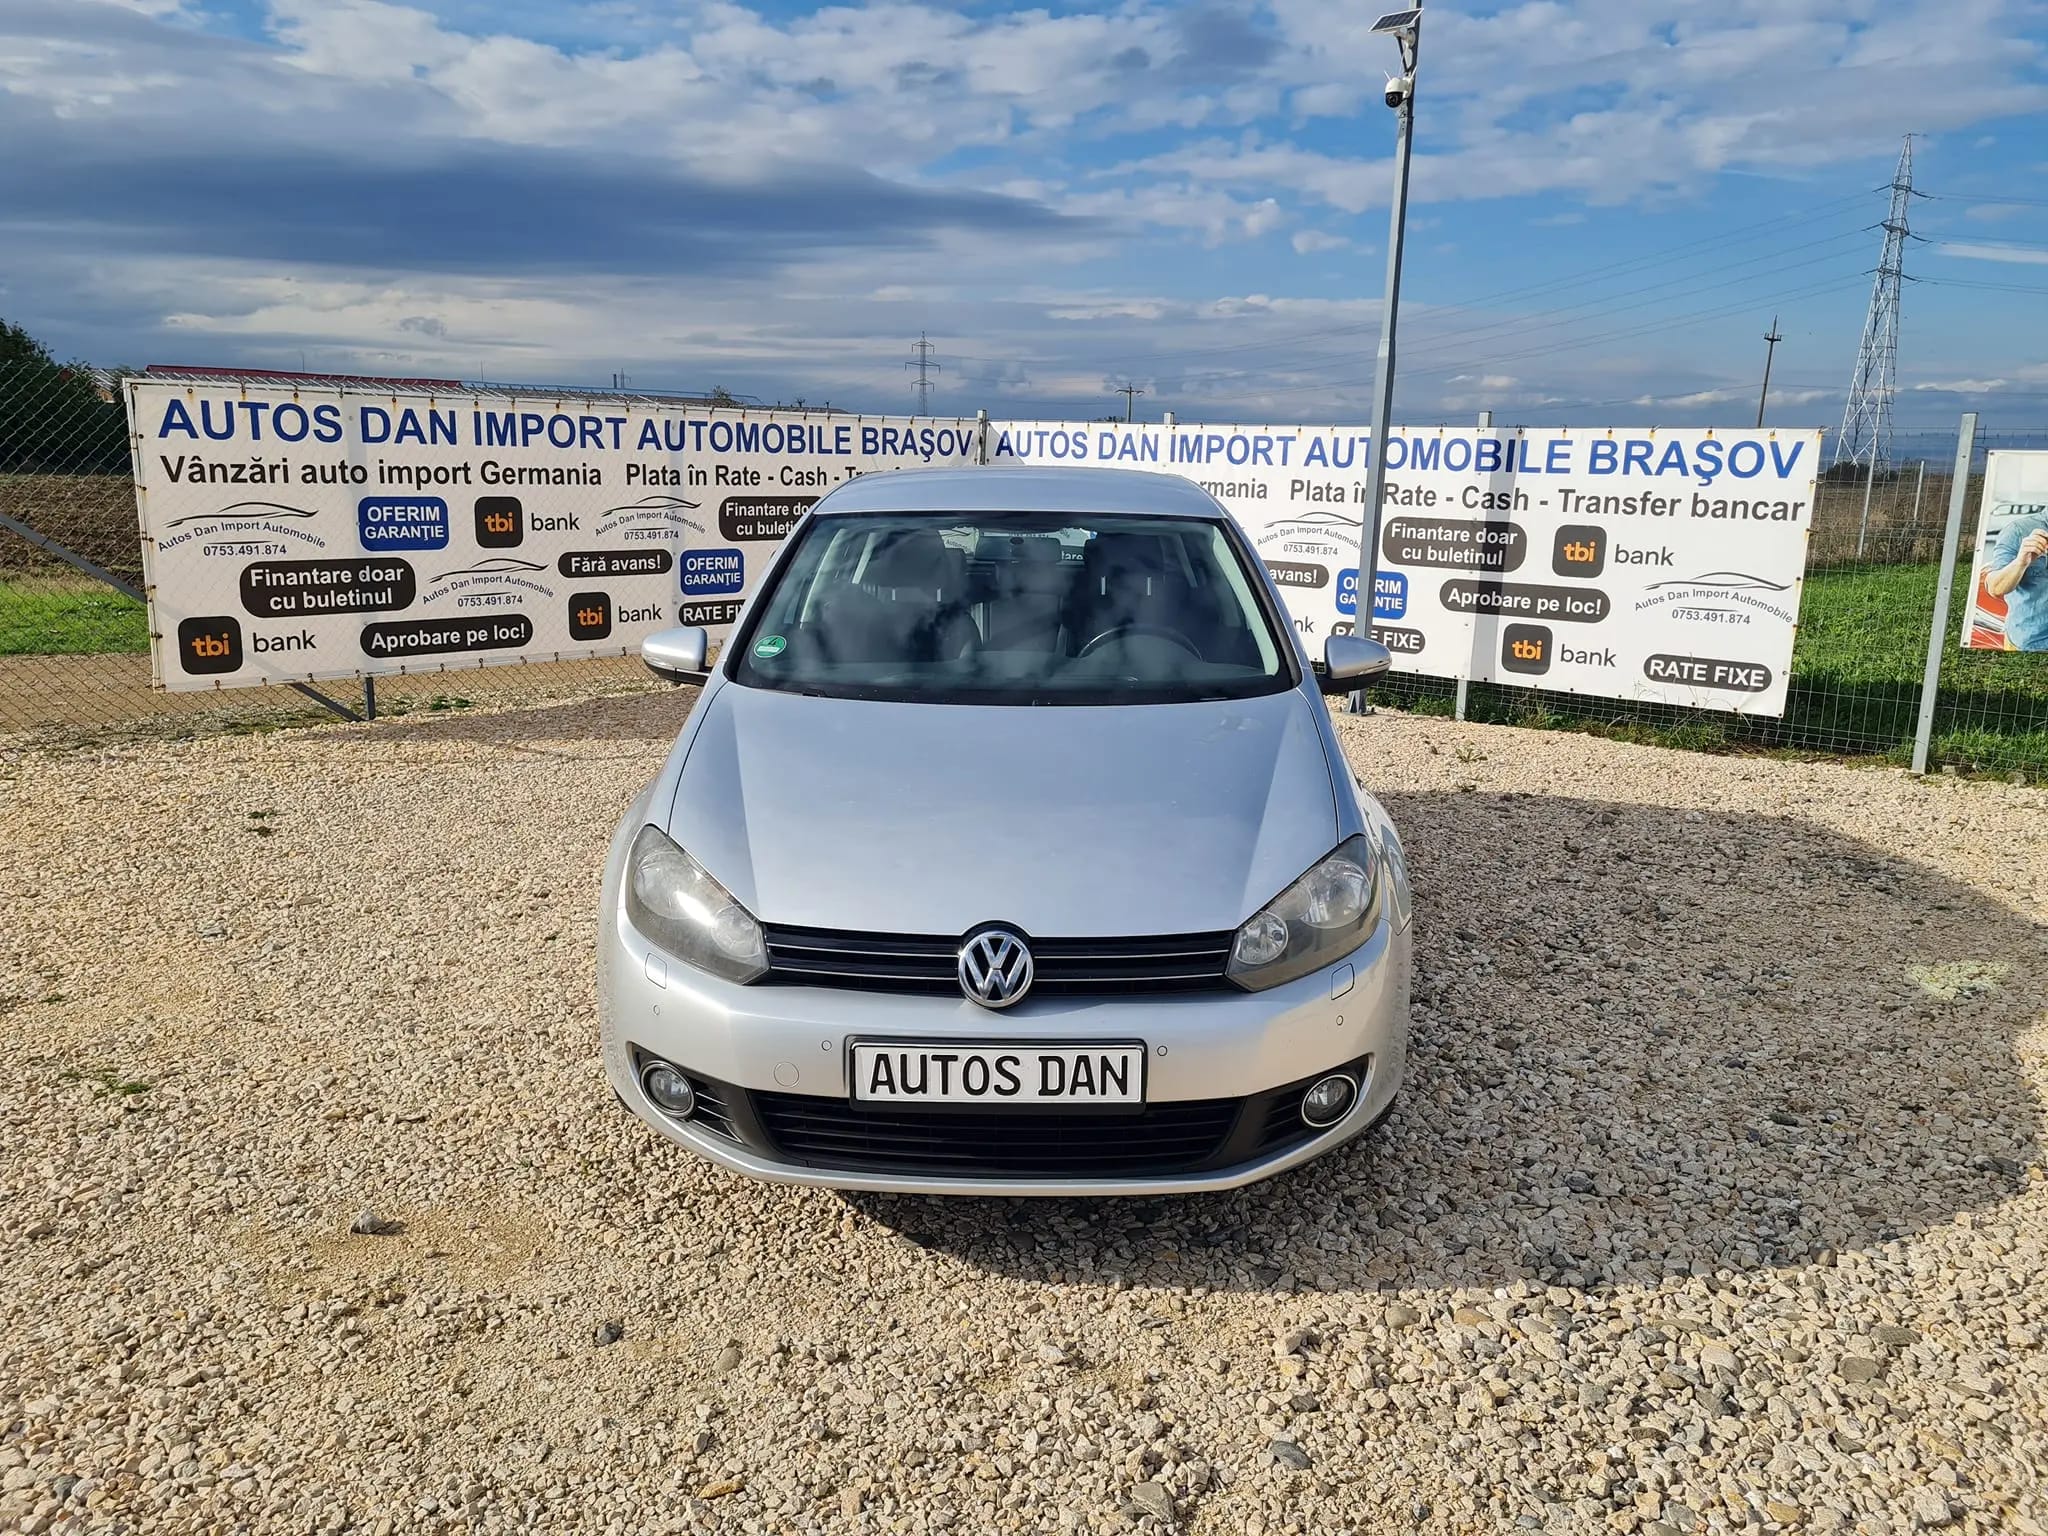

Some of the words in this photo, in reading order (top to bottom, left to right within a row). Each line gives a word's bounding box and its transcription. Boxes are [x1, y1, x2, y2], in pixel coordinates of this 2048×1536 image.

[158, 399, 343, 443] AUTOS
[360, 406, 457, 445] DAN
[474, 411, 627, 450] IMPORT
[637, 418, 851, 455] AUTOMOBILE
[995, 430, 1088, 459] AUTOS
[1098, 432, 1159, 462] DAN
[1170, 434, 1297, 467] IMPORT
[160, 455, 289, 484] Vânzări
[301, 459, 368, 484] auto
[378, 459, 472, 491] import
[480, 460, 602, 485] Germania
[626, 463, 682, 486] Plata
[688, 465, 708, 486] în
[715, 465, 761, 487] Rate
[780, 466, 828, 486] Cash
[1200, 478, 1268, 499] mania
[725, 502, 790, 517] Finantare
[792, 502, 809, 516] do
[1290, 479, 1346, 503] Plata
[1383, 482, 1437, 507] Rate
[1461, 485, 1529, 510] Cash
[1558, 488, 1682, 517] Transfer
[1690, 492, 1806, 522] bancar
[367, 506, 441, 522] OFERIM
[484, 511, 514, 533] tbi
[530, 512, 580, 532] bank
[595, 521, 619, 537] Autos
[619, 515, 635, 525] Dan
[636, 511, 663, 522] Import
[663, 512, 706, 535] Automobile
[157, 531, 193, 552] Autos
[193, 524, 219, 537] Dan
[221, 521, 260, 533] Import
[262, 521, 326, 549] Automobile
[624, 530, 679, 541] 0753.491.874
[736, 524, 753, 536] cu
[1257, 532, 1279, 547] Autos
[1279, 527, 1295, 537] Dan
[1297, 526, 1323, 535] Import
[1391, 522, 1470, 543] Finantare
[1475, 527, 1518, 545] doar
[203, 544, 288, 557] 0753.491.874
[1283, 543, 1338, 556] 0753.491.874
[1401, 546, 1422, 560] cu
[1427, 545, 1504, 566] buletinul
[1563, 541, 1596, 563] tbi
[1614, 544, 1675, 567] bank
[571, 555, 607, 574] Fără
[611, 554, 662, 572] avans!
[686, 556, 739, 572] OFERIM
[250, 567, 353, 587] Finantare
[358, 565, 405, 583] doar
[1269, 568, 1318, 584] avans!
[1343, 576, 1402, 594] ORIM
[269, 595, 296, 610] cu
[302, 587, 393, 608] buletinul
[421, 586, 450, 605] Autos
[450, 579, 470, 591] Dan
[471, 576, 503, 587] Import
[504, 575, 554, 598] Automobile
[457, 594, 523, 608] 0753.491.874
[1339, 593, 1404, 611] GANŢIE
[1447, 588, 1531, 610] Aprobare
[1536, 598, 1560, 614] pe
[1565, 596, 1602, 616] loc!
[1634, 596, 1666, 612] Autos
[1667, 590, 1690, 602] Dan
[1692, 588, 1730, 600] Import
[1731, 592, 1793, 623] Automobile
[577, 606, 603, 627] tbi
[618, 603, 663, 623] bank
[683, 605, 722, 622] RATE
[1294, 616, 1314, 633] nk
[1671, 608, 1752, 625] 0753.491.874
[191, 632, 230, 657] tbi
[252, 629, 317, 653] bank
[371, 629, 461, 652] Aprobare
[466, 628, 489, 646] pe
[493, 623, 526, 642] loc!
[1383, 631, 1421, 649] FIXE
[1511, 639, 1543, 661] tbi
[1560, 643, 1617, 668] bank
[1649, 659, 1708, 681] RATE
[1713, 665, 1767, 687] FIXE
[869, 1053, 1021, 1096] AUTOS
[1038, 1055, 1128, 1096] DAN
